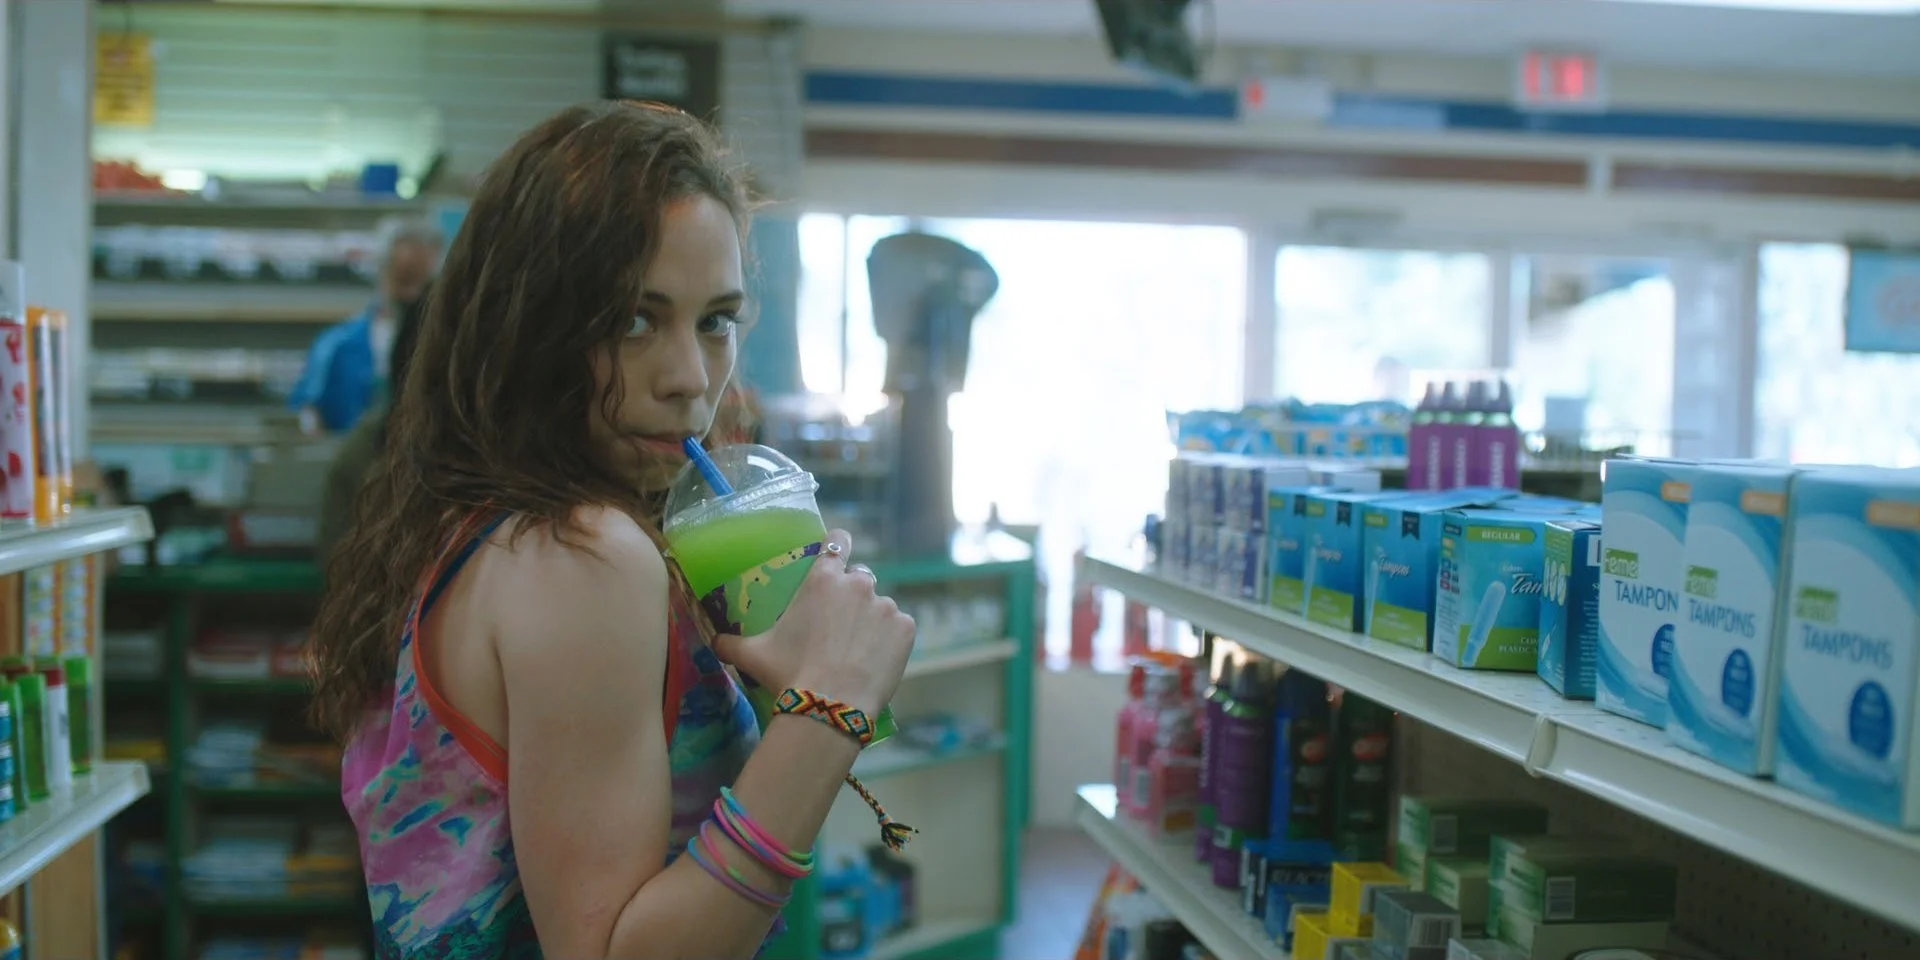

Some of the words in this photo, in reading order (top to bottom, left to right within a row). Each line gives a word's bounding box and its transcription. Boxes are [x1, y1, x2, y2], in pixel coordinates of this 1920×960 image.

[1481, 530, 1521, 541] REGULAR
[1603, 549, 1639, 578] Feme
[1615, 580, 1679, 613] TAMPON
[1688, 599, 1756, 638] TAMPONS
[1802, 623, 1894, 670] TAMPONS
